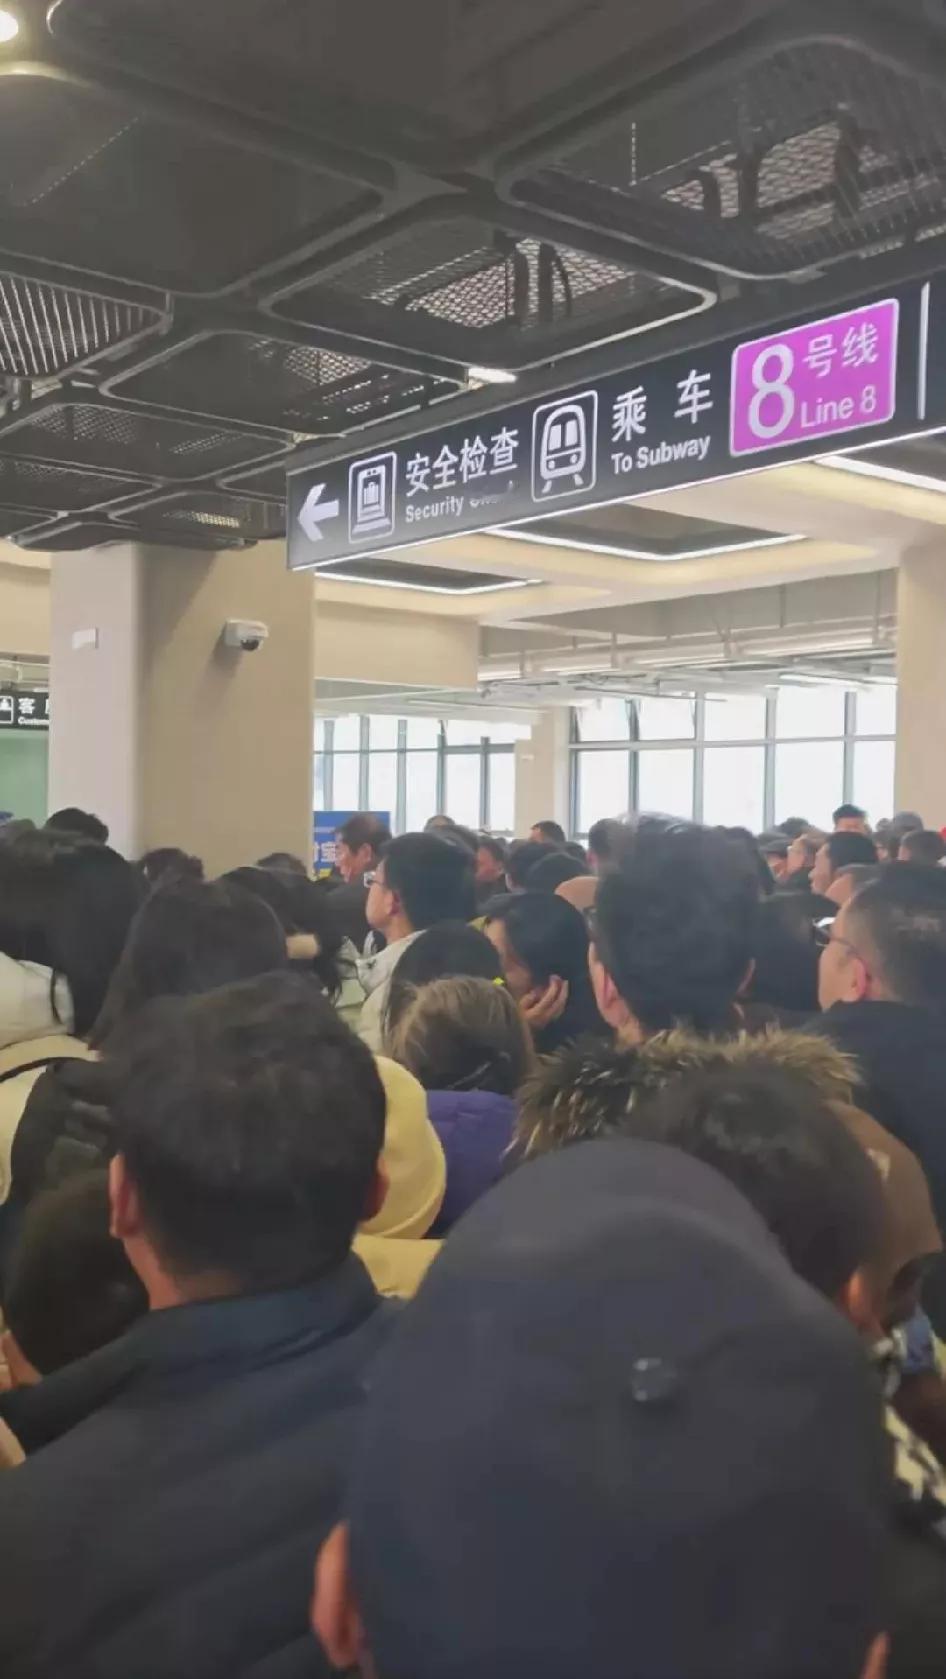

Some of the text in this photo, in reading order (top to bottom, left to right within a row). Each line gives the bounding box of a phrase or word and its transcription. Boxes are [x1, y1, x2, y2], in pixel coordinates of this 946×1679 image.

[802, 322, 878, 378] 号线
[748, 343, 795, 439] 8
[800, 384, 877, 429] Line 8
[405, 426, 519, 497] 安全检查
[611, 435, 711, 475] To Subway
[405, 496, 464, 522] Security
[18, 697, 49, 714] 客
